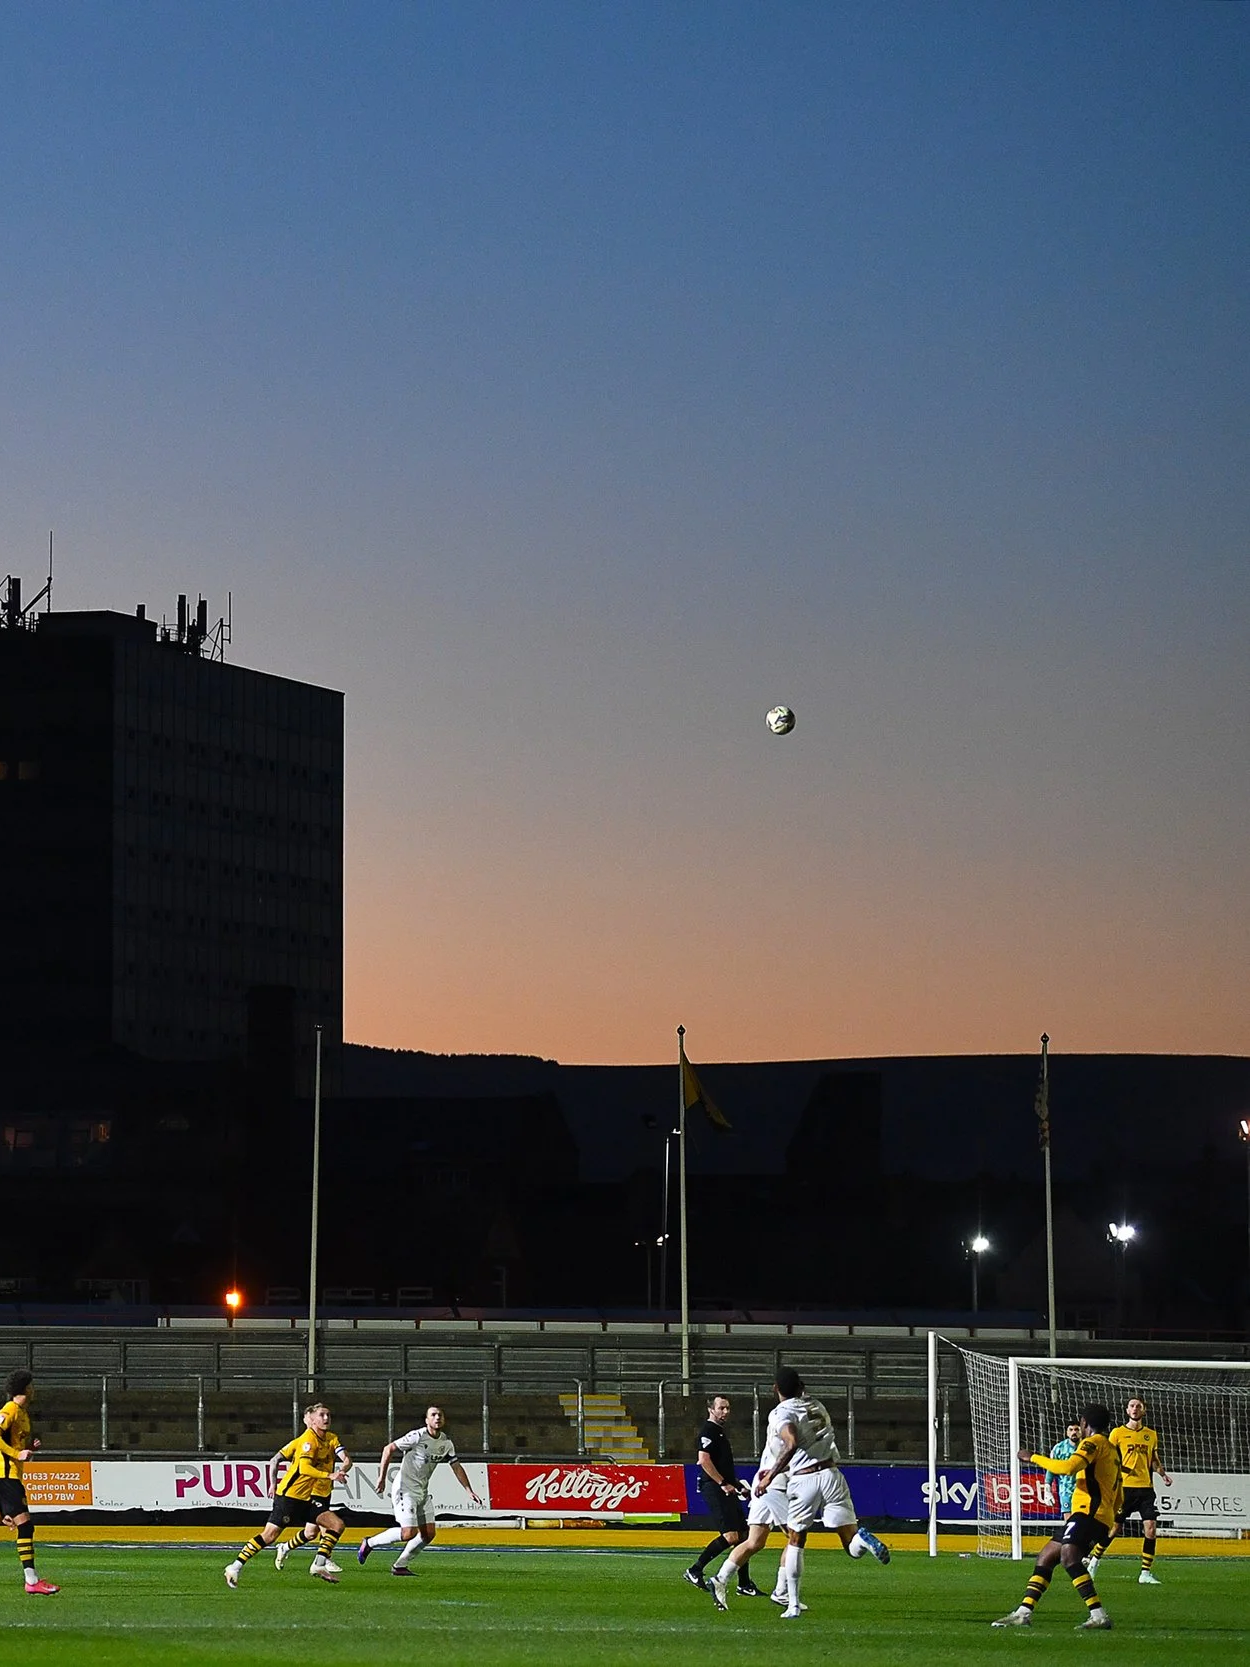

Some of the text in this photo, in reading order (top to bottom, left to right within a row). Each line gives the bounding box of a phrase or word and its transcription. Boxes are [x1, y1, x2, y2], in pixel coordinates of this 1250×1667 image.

[22, 1473, 47, 1481] 01633
[26, 1482, 89, 1491] Caerleon Road
[525, 1468, 642, 1509] Kellogg's
[55, 1493, 74, 1501] 7BW
[921, 1475, 1047, 1511] sky bet
[1187, 1497, 1243, 1512] TYRES
